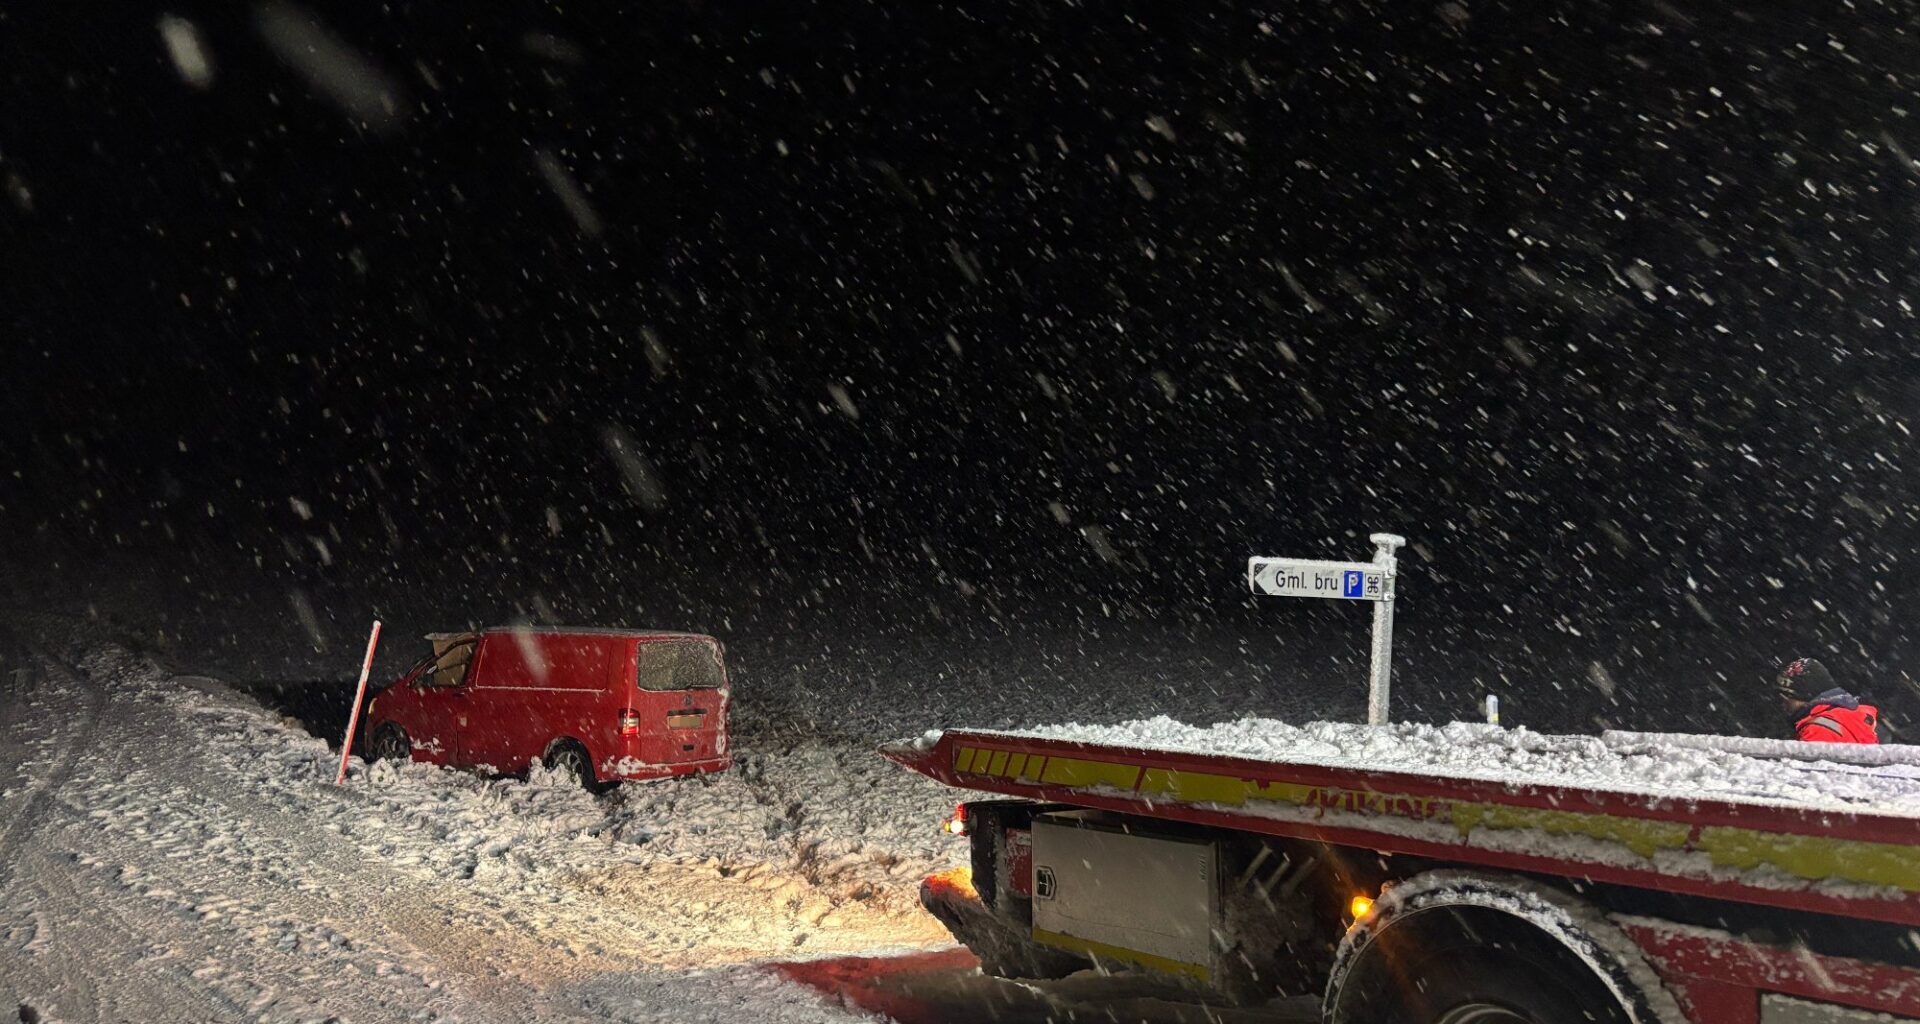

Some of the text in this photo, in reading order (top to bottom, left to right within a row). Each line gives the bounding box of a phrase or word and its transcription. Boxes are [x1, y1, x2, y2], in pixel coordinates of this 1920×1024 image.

[1275, 570, 1359, 594] Gml. bru P
